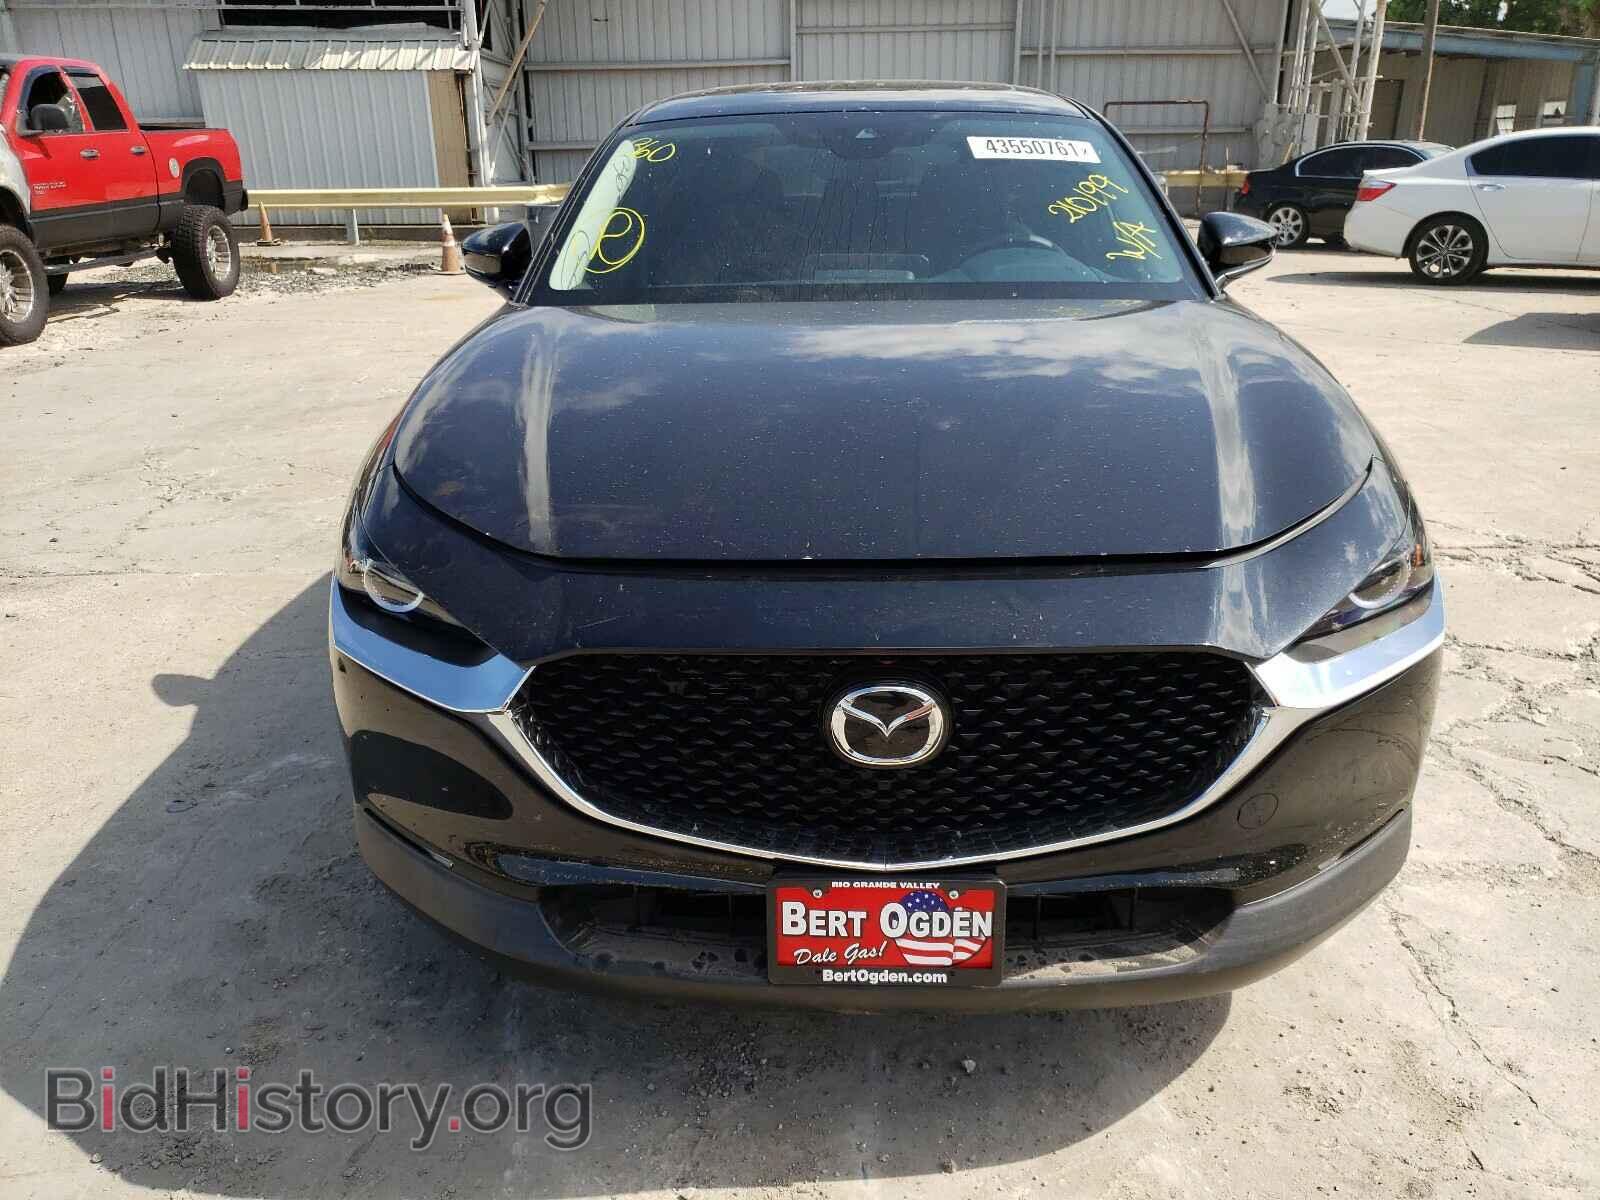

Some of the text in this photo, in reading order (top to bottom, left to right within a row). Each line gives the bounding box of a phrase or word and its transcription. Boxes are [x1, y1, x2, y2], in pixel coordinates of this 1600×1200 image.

[986, 138, 1079, 157] 43550761
[853, 881, 898, 889] GRANDE
[900, 881, 940, 889] VALLEY
[781, 901, 993, 938] BERT OGDEN
[793, 940, 888, 965] Dale Gas!
[822, 969, 948, 984] BertOgden.com
